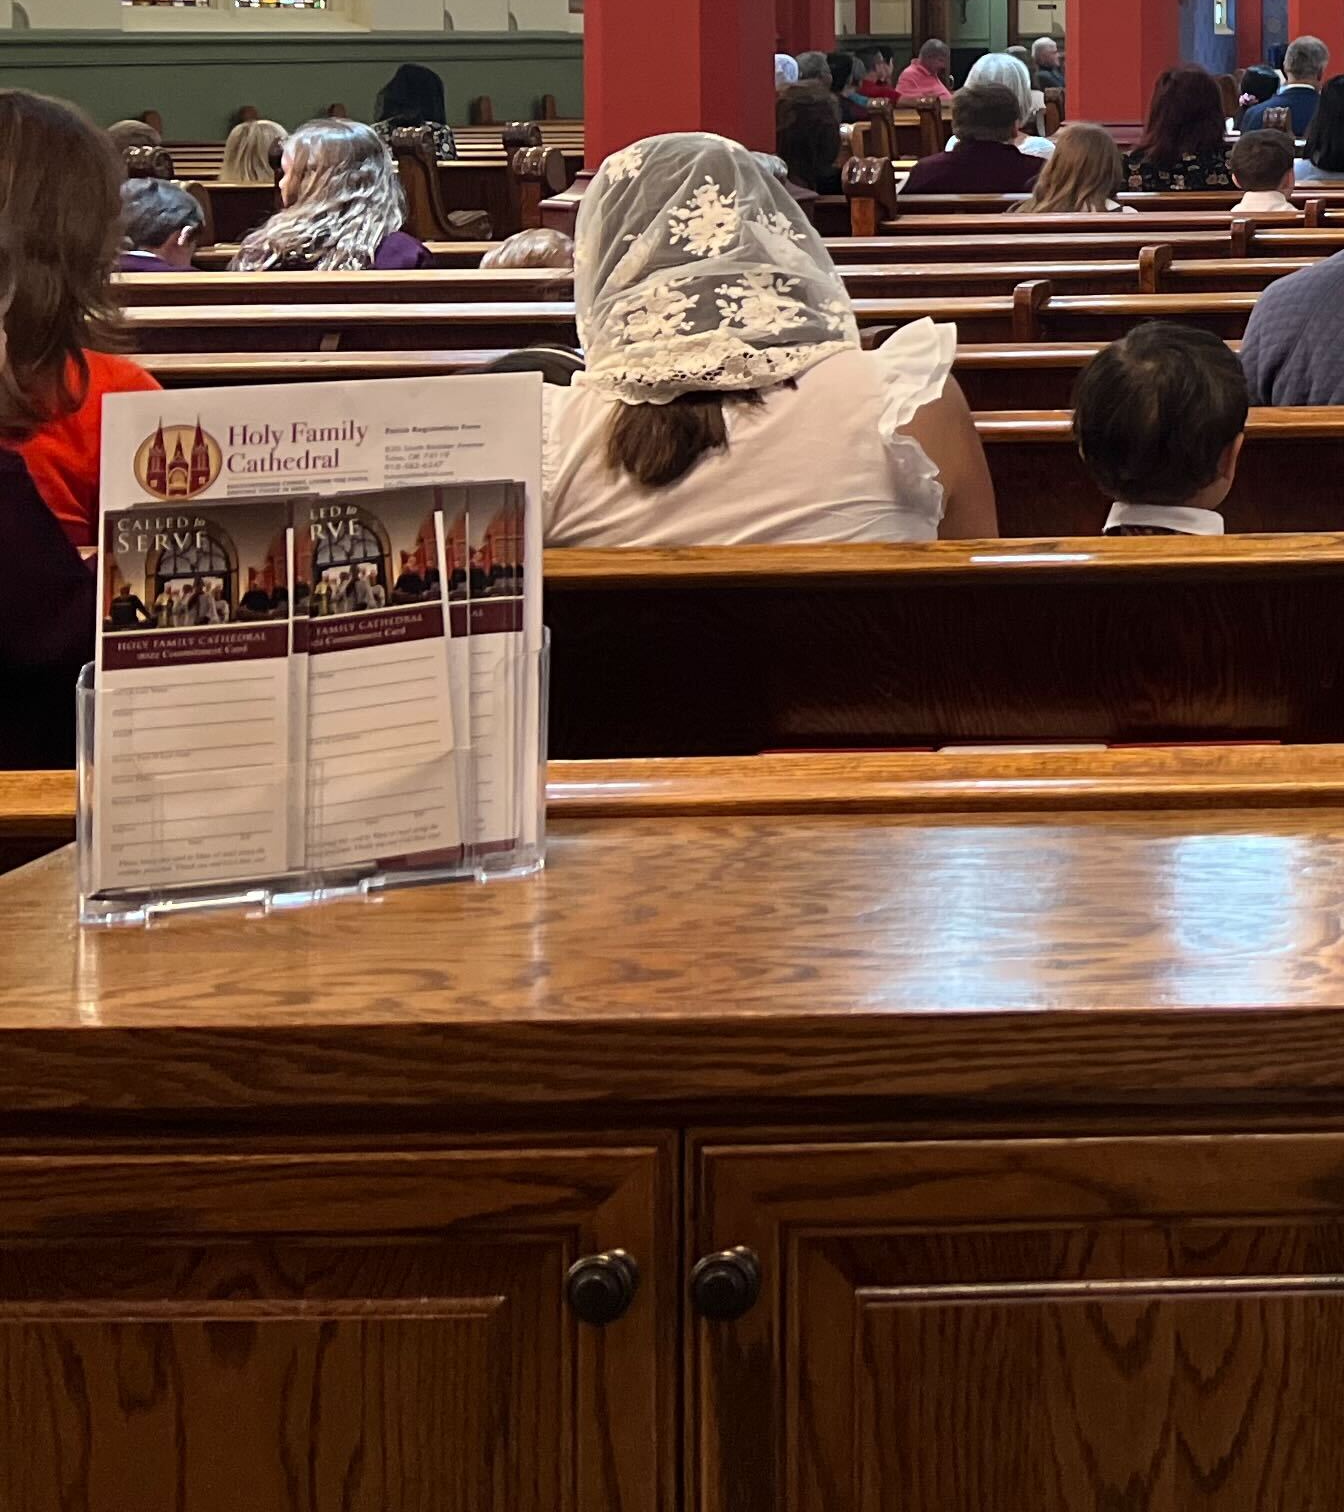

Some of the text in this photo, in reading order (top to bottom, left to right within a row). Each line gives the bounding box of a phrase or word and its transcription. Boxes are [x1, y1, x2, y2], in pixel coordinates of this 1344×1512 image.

[228, 419, 369, 452] Holy Family
[227, 448, 339, 473] Cathedral
[118, 516, 206, 531] CALLED to
[118, 531, 207, 553] SERVE
[358, 614, 423, 630] CATHEDRAL
[153, 638, 194, 649] FAMILY
[198, 632, 266, 645] CATHEDRAL
